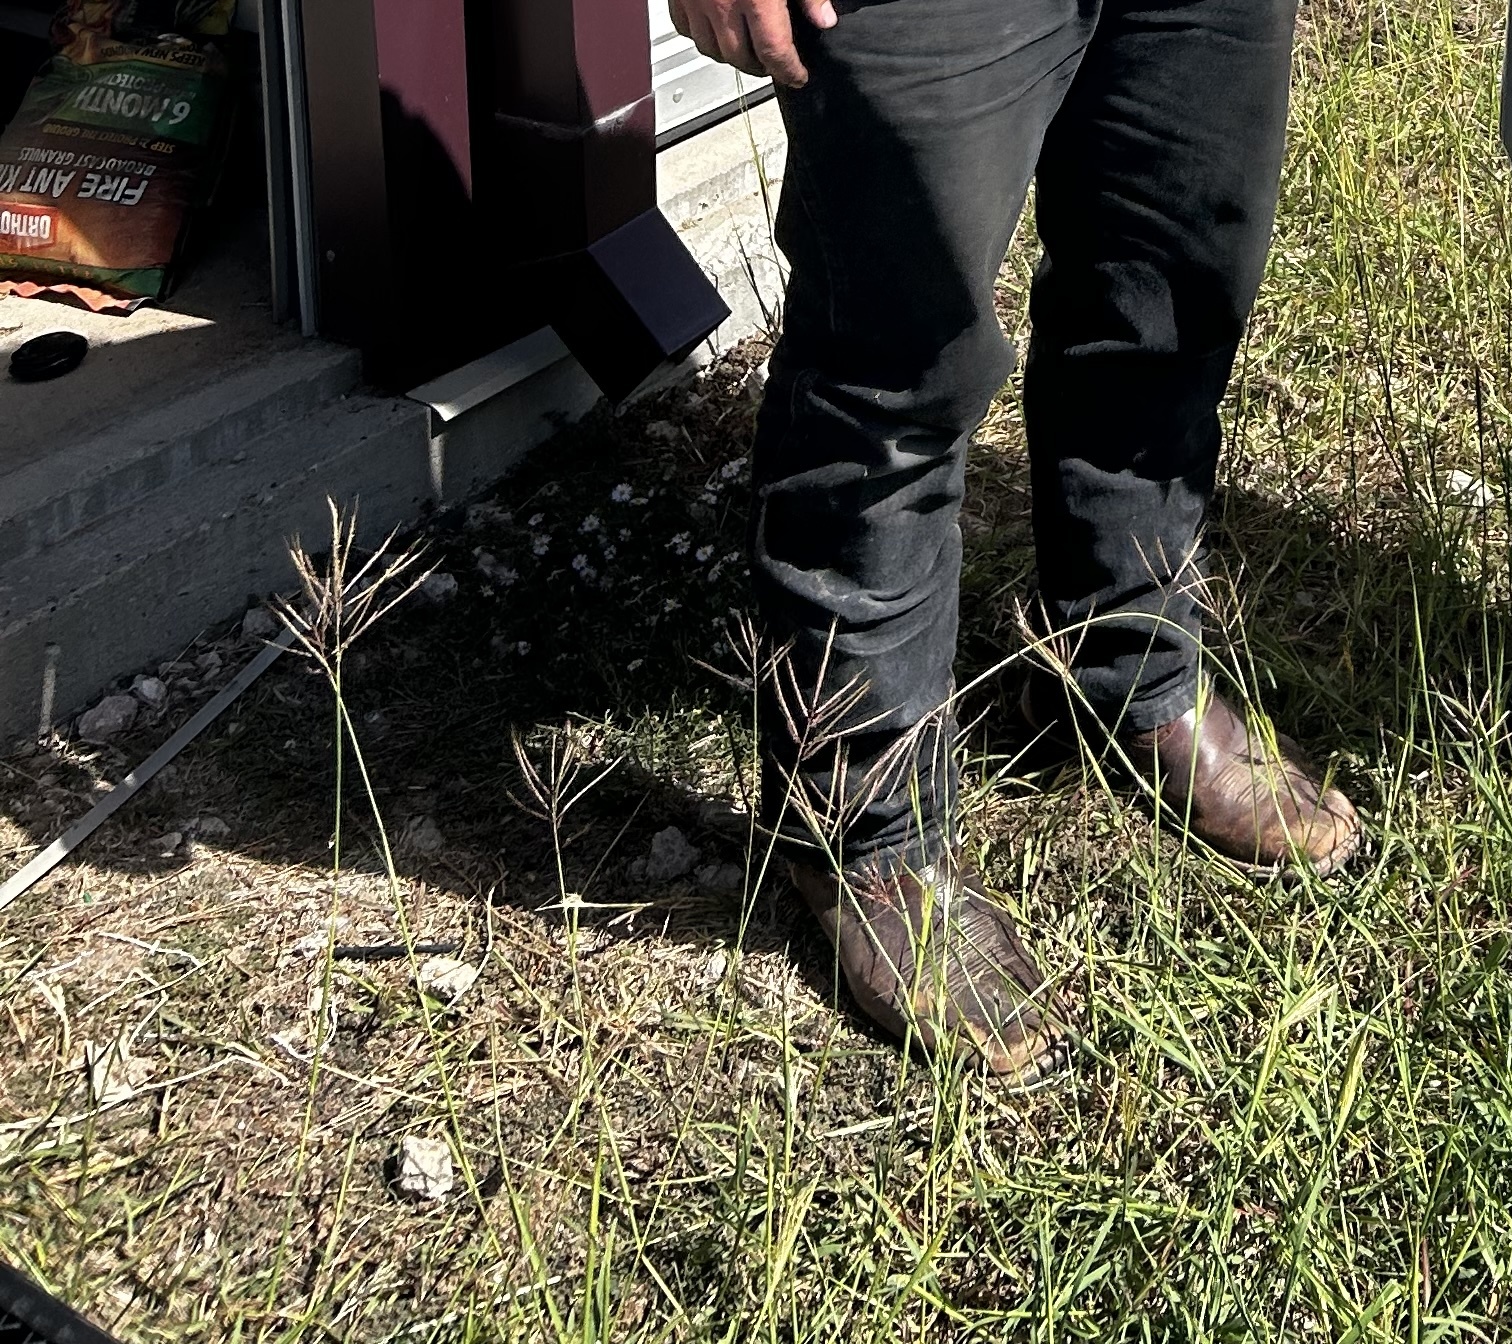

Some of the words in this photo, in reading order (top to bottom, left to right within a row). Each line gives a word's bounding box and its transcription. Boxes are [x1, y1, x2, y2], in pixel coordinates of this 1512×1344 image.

[72, 86, 171, 123] MONTH
[169, 101, 191, 125] 6
[98, 130, 138, 146] PROTECT
[149, 140, 176, 155] STEP
[17, 146, 75, 166] GRANULES
[73, 153, 157, 177] BROADCAST
[18, 166, 76, 199] ANT
[76, 172, 149, 206] FIRE
[0, 210, 51, 240] ORTHO
